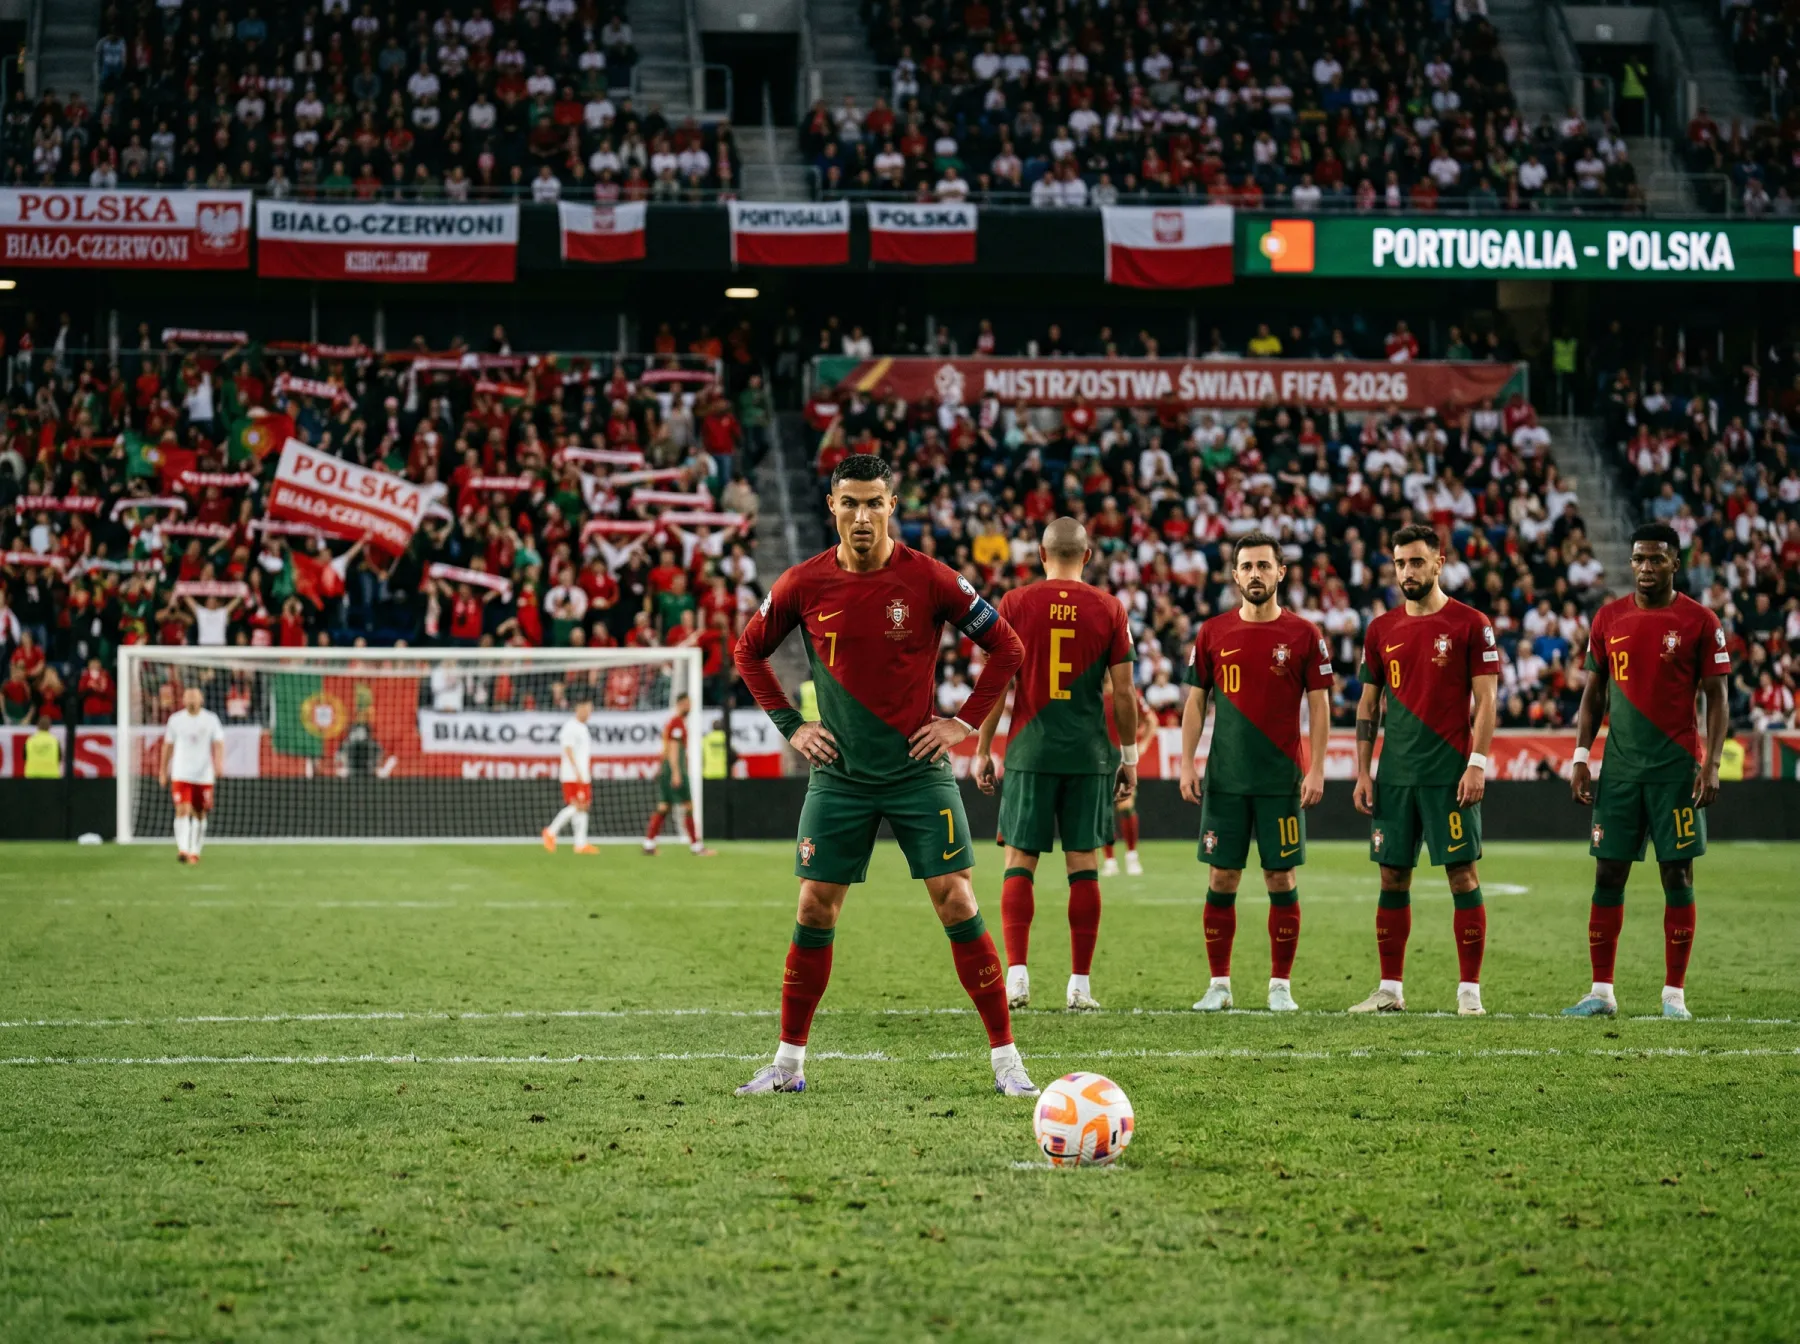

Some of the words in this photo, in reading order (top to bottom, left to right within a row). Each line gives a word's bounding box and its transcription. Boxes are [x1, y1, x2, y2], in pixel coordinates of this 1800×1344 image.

[18, 194, 178, 222] POLSKA
[738, 208, 843, 226] PORTUGALIA
[878, 209, 968, 227] POLSKA
[270, 211, 504, 235] BIAŁO-CZERWONI
[5, 233, 190, 261] BIAŁO-CZERWONI
[1372, 227, 1578, 269] PORTUGALIA
[1583, 245, 1600, 257] -
[1606, 230, 1735, 271] POLSKA
[984, 368, 1173, 400] MISTRZOSTWA
[1178, 363, 1277, 401] ŚWIATA
[1281, 370, 1337, 401] FIFA
[1343, 371, 1408, 401] 2026
[292, 453, 422, 516] POLSKA
[1049, 603, 1077, 621] PEPE
[824, 632, 837, 667] 7
[1221, 664, 1241, 693] 10
[1390, 660, 1400, 689] 8
[1611, 651, 1629, 681] 12
[433, 722, 664, 743] BIAŁO-CZRWON
[939, 808, 955, 844] 7
[1278, 816, 1299, 846] 10
[1448, 811, 1463, 840] 8
[1672, 807, 1696, 838] 12
